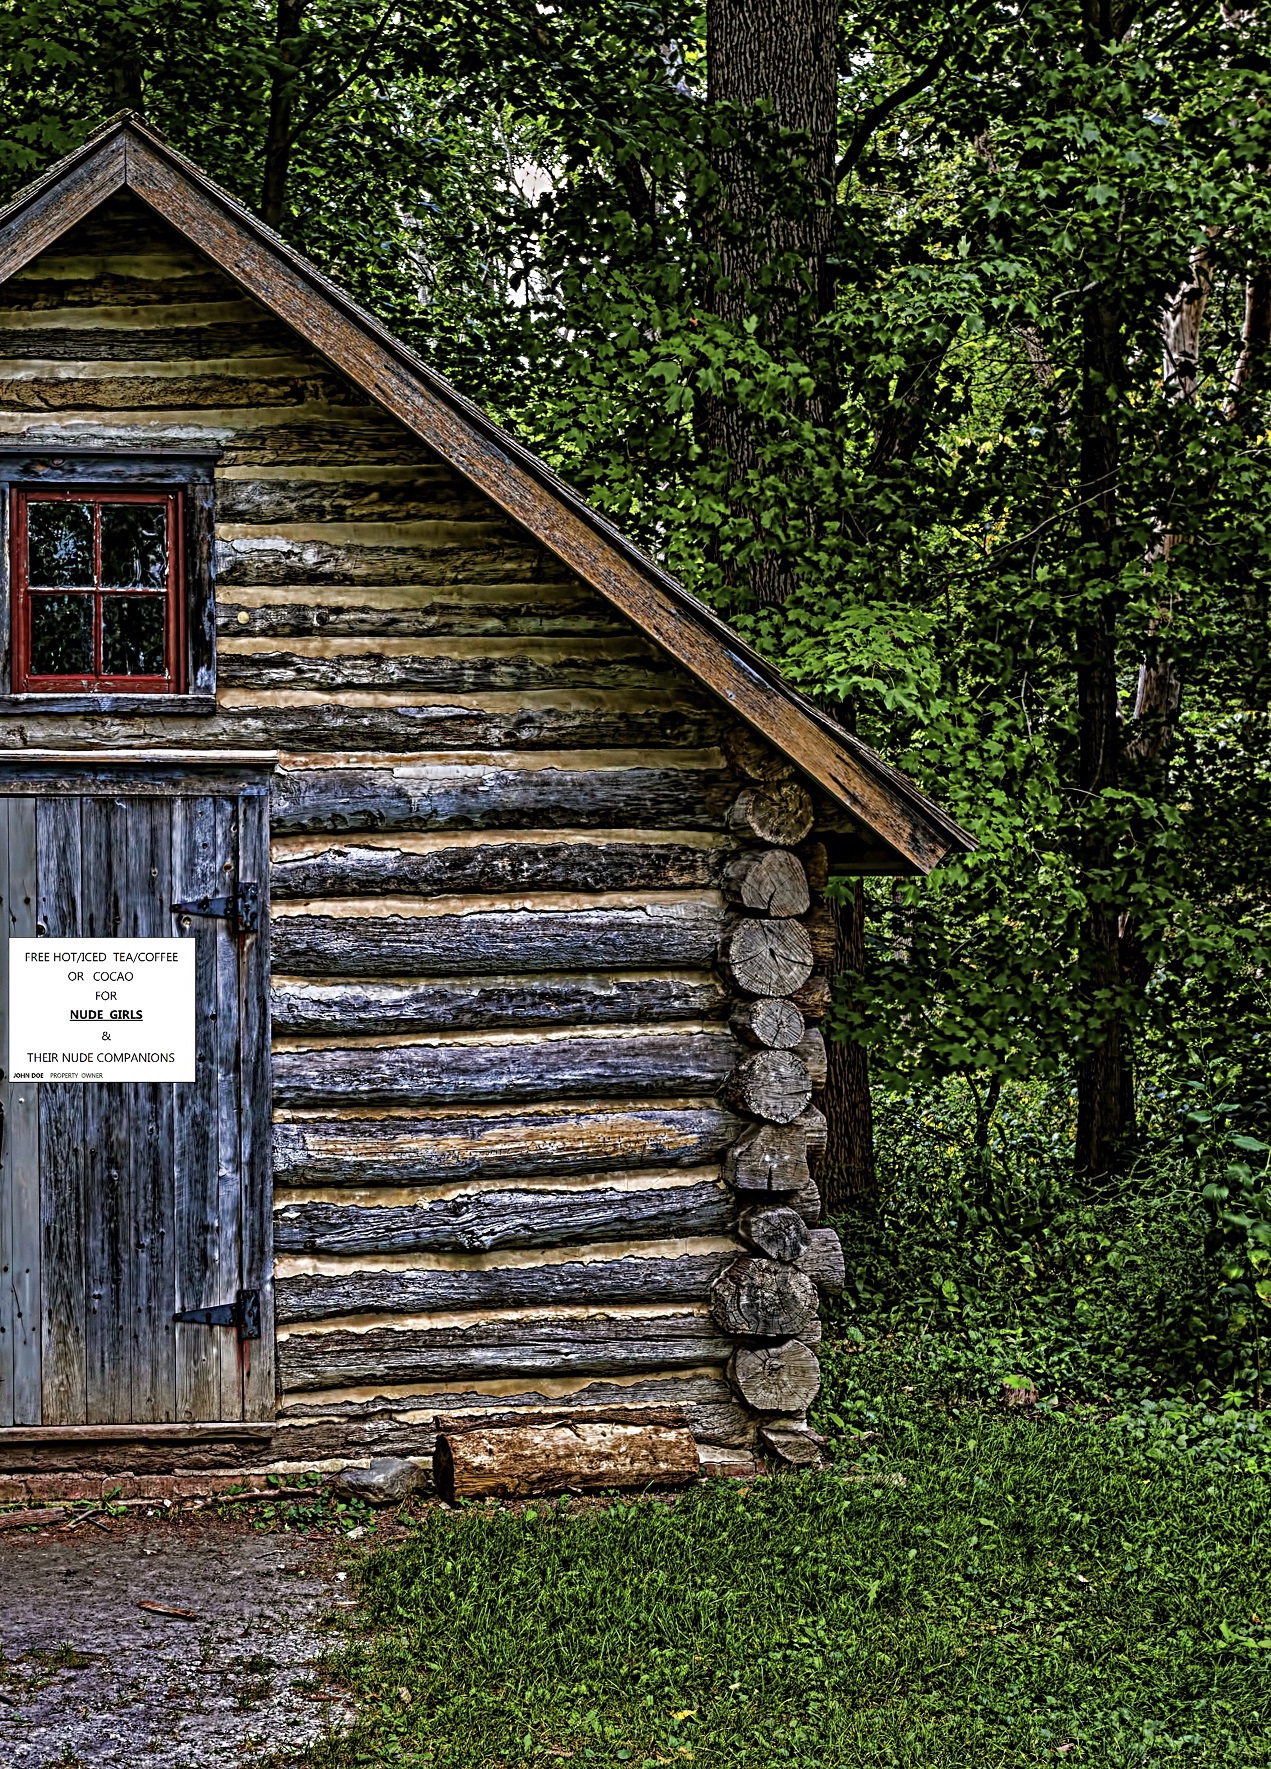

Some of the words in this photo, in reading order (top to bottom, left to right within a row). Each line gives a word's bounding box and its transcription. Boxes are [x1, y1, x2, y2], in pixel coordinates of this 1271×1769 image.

[25, 952, 50, 962] FREE
[53, 952, 107, 963] HOT/ICED
[112, 952, 179, 963] TEA/COFFEE
[67, 971, 85, 982] OR
[92, 971, 134, 982] COCAO
[95, 991, 118, 1001] FOR
[70, 1009, 104, 1020] NUDE
[109, 1009, 144, 1020] GIRLS
[101, 1031, 112, 1041] &
[26, 1052, 59, 1063] THEIR
[62, 1052, 94, 1063] NUDE
[96, 1052, 176, 1063] COMPANIONS
